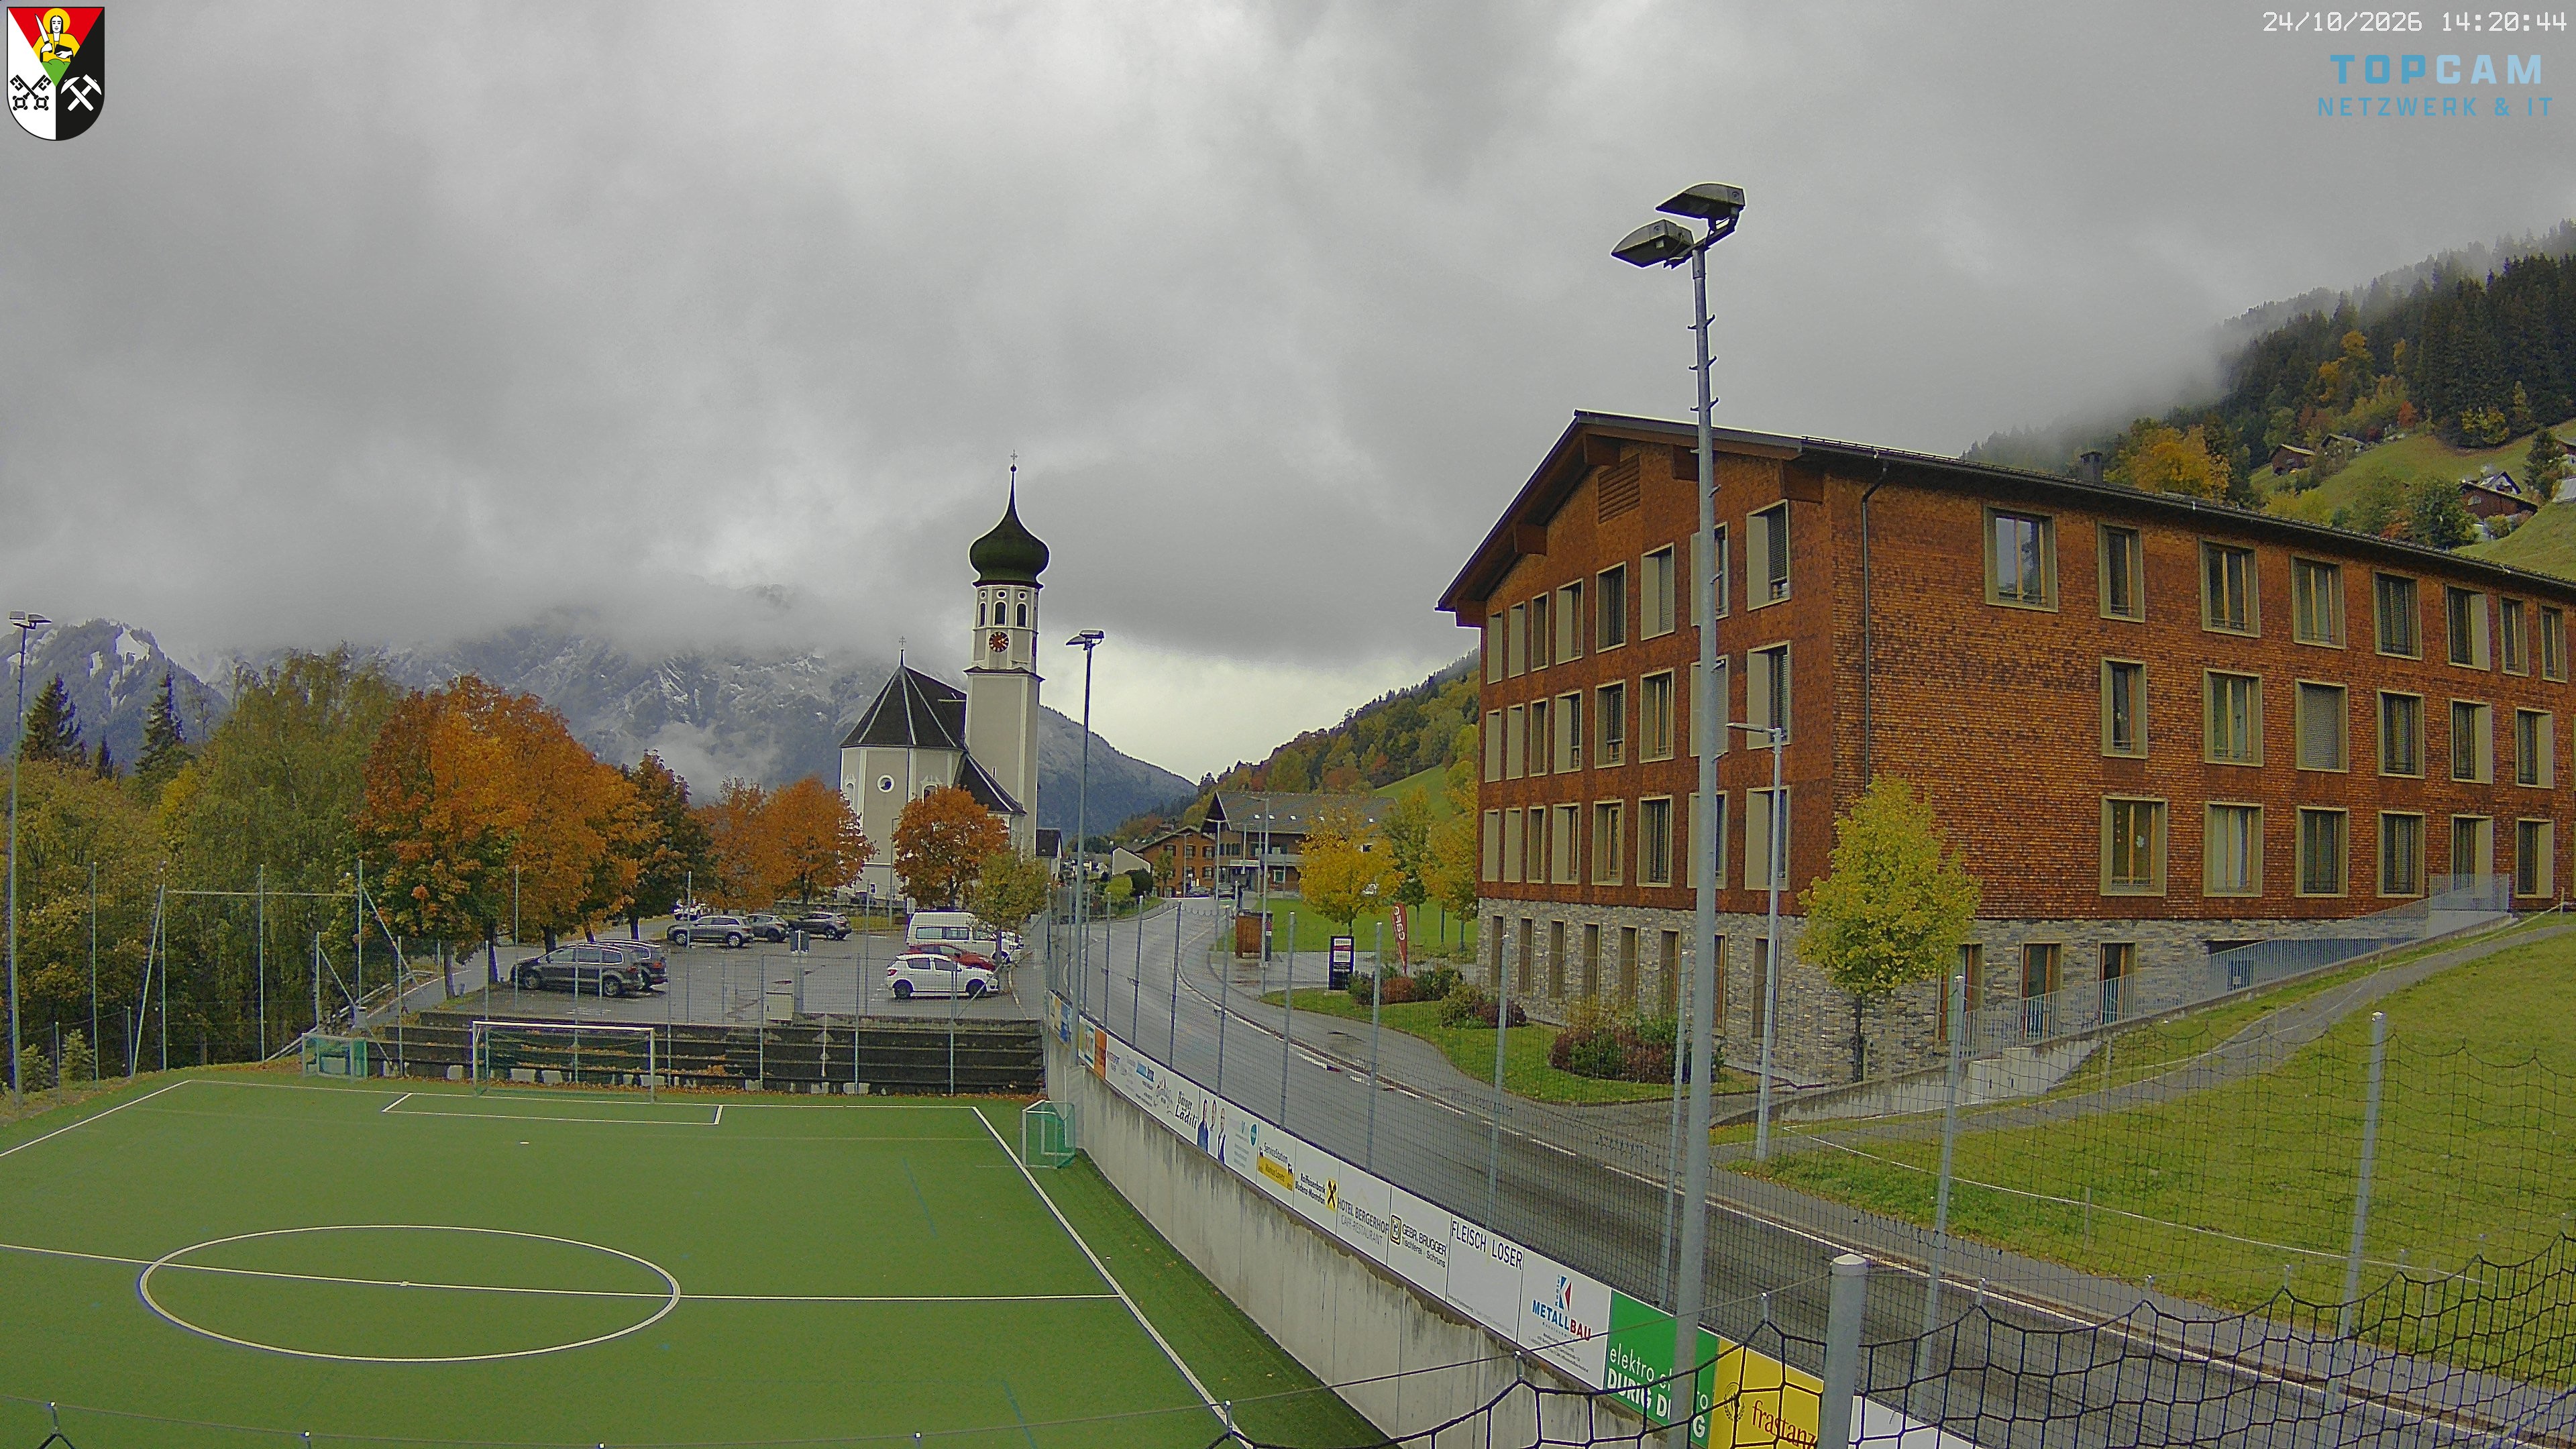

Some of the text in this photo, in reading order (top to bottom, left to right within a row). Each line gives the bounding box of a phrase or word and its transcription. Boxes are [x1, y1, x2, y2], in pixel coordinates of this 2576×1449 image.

[1338, 1197, 1389, 1235] HOTEL BERGERHOF
[1402, 1224, 1418, 1242] GEBR.
[1402, 1236, 1446, 1269] Tischlerei Schruns
[1451, 1220, 1523, 1271] FLEISCH LOSER
[1532, 1299, 1591, 1342] METALLBAU
[1610, 1343, 1654, 1383] elektro
